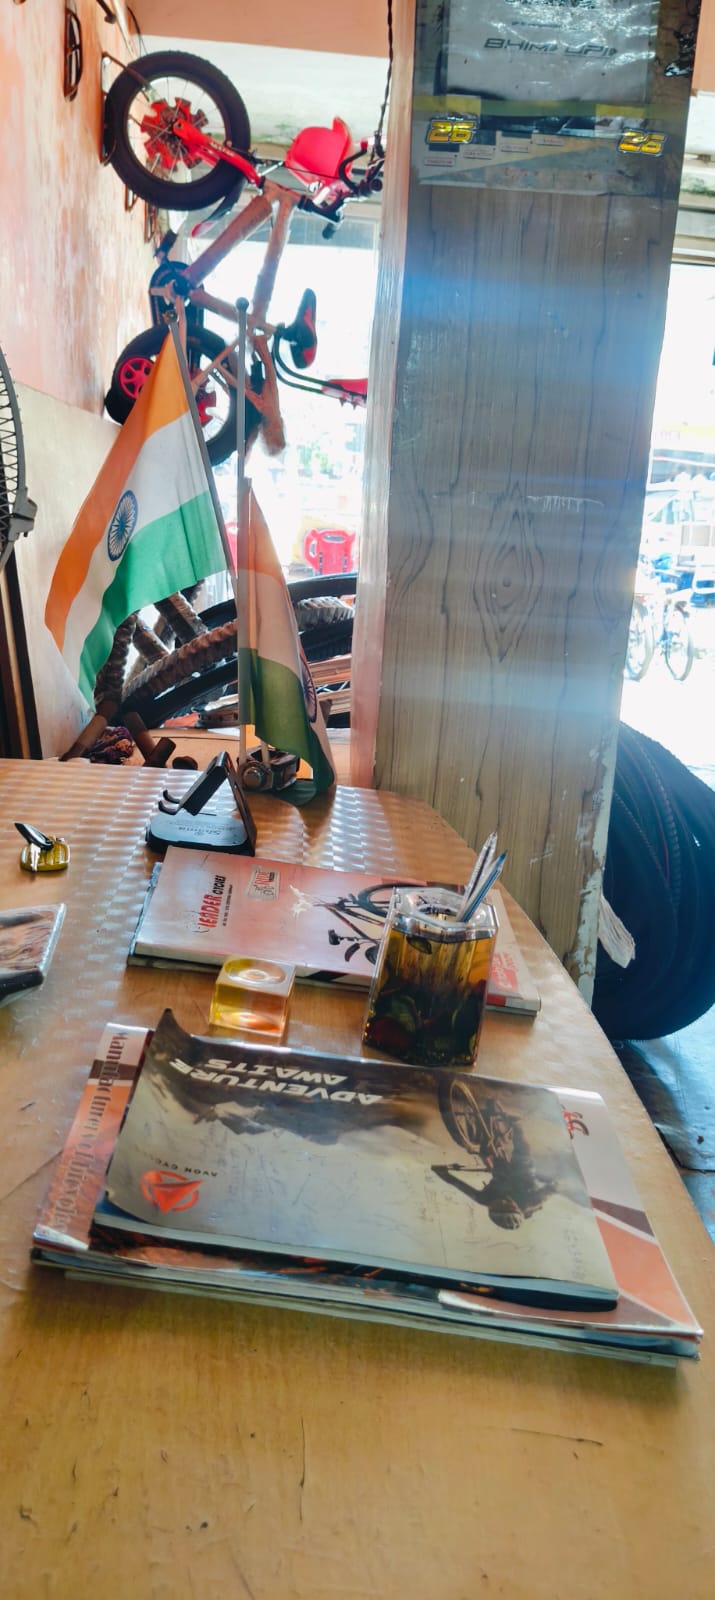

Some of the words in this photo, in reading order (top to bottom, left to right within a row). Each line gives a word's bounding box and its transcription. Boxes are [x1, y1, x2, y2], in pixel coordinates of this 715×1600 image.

[484, 37, 552, 53] BHIM
[198, 893, 222, 929] LEADER
[169, 1057, 383, 1105] ADVENTURE
[207, 1058, 348, 1086] AWAITS
[184, 1167, 218, 1178] AVON
